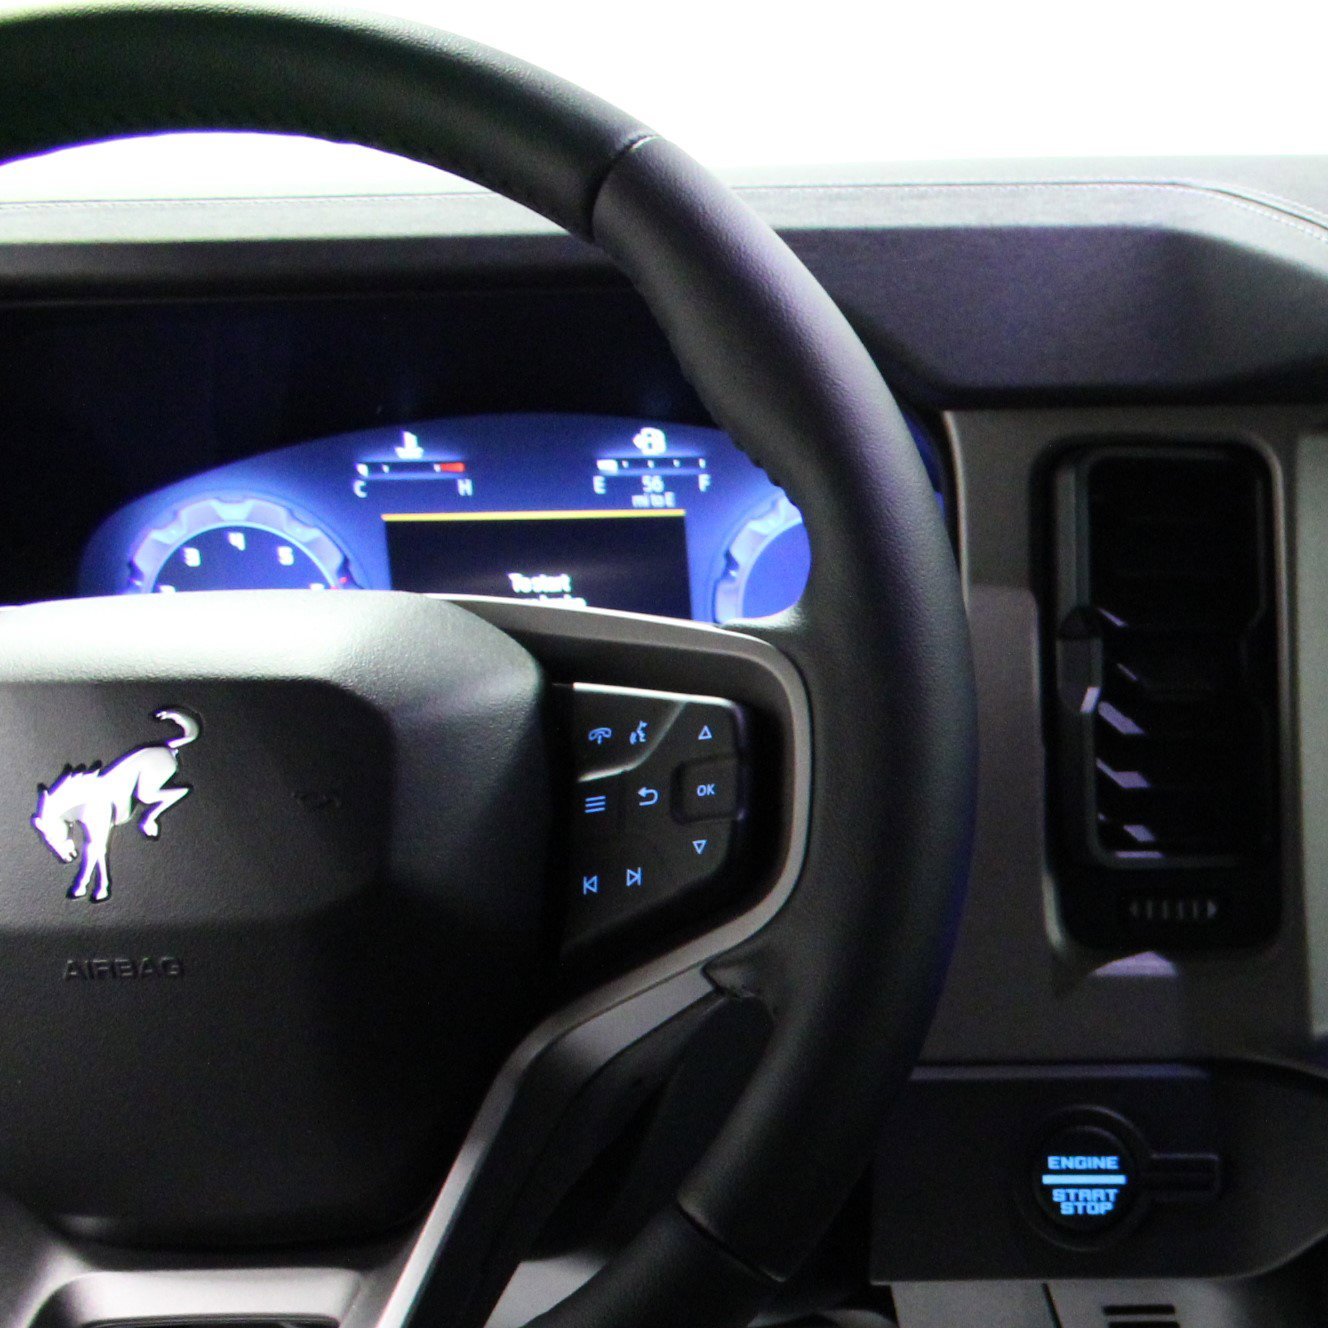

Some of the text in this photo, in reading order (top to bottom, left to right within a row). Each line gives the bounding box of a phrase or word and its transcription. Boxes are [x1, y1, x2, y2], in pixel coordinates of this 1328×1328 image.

[353, 479, 473, 498] C H
[593, 474, 711, 494] E F
[697, 783, 715, 798] OK
[62, 957, 185, 982] AIRBAG
[1047, 1155, 1120, 1170] ENGINE
[1052, 1188, 1120, 1202] START
[1060, 1202, 1114, 1216] STOP
